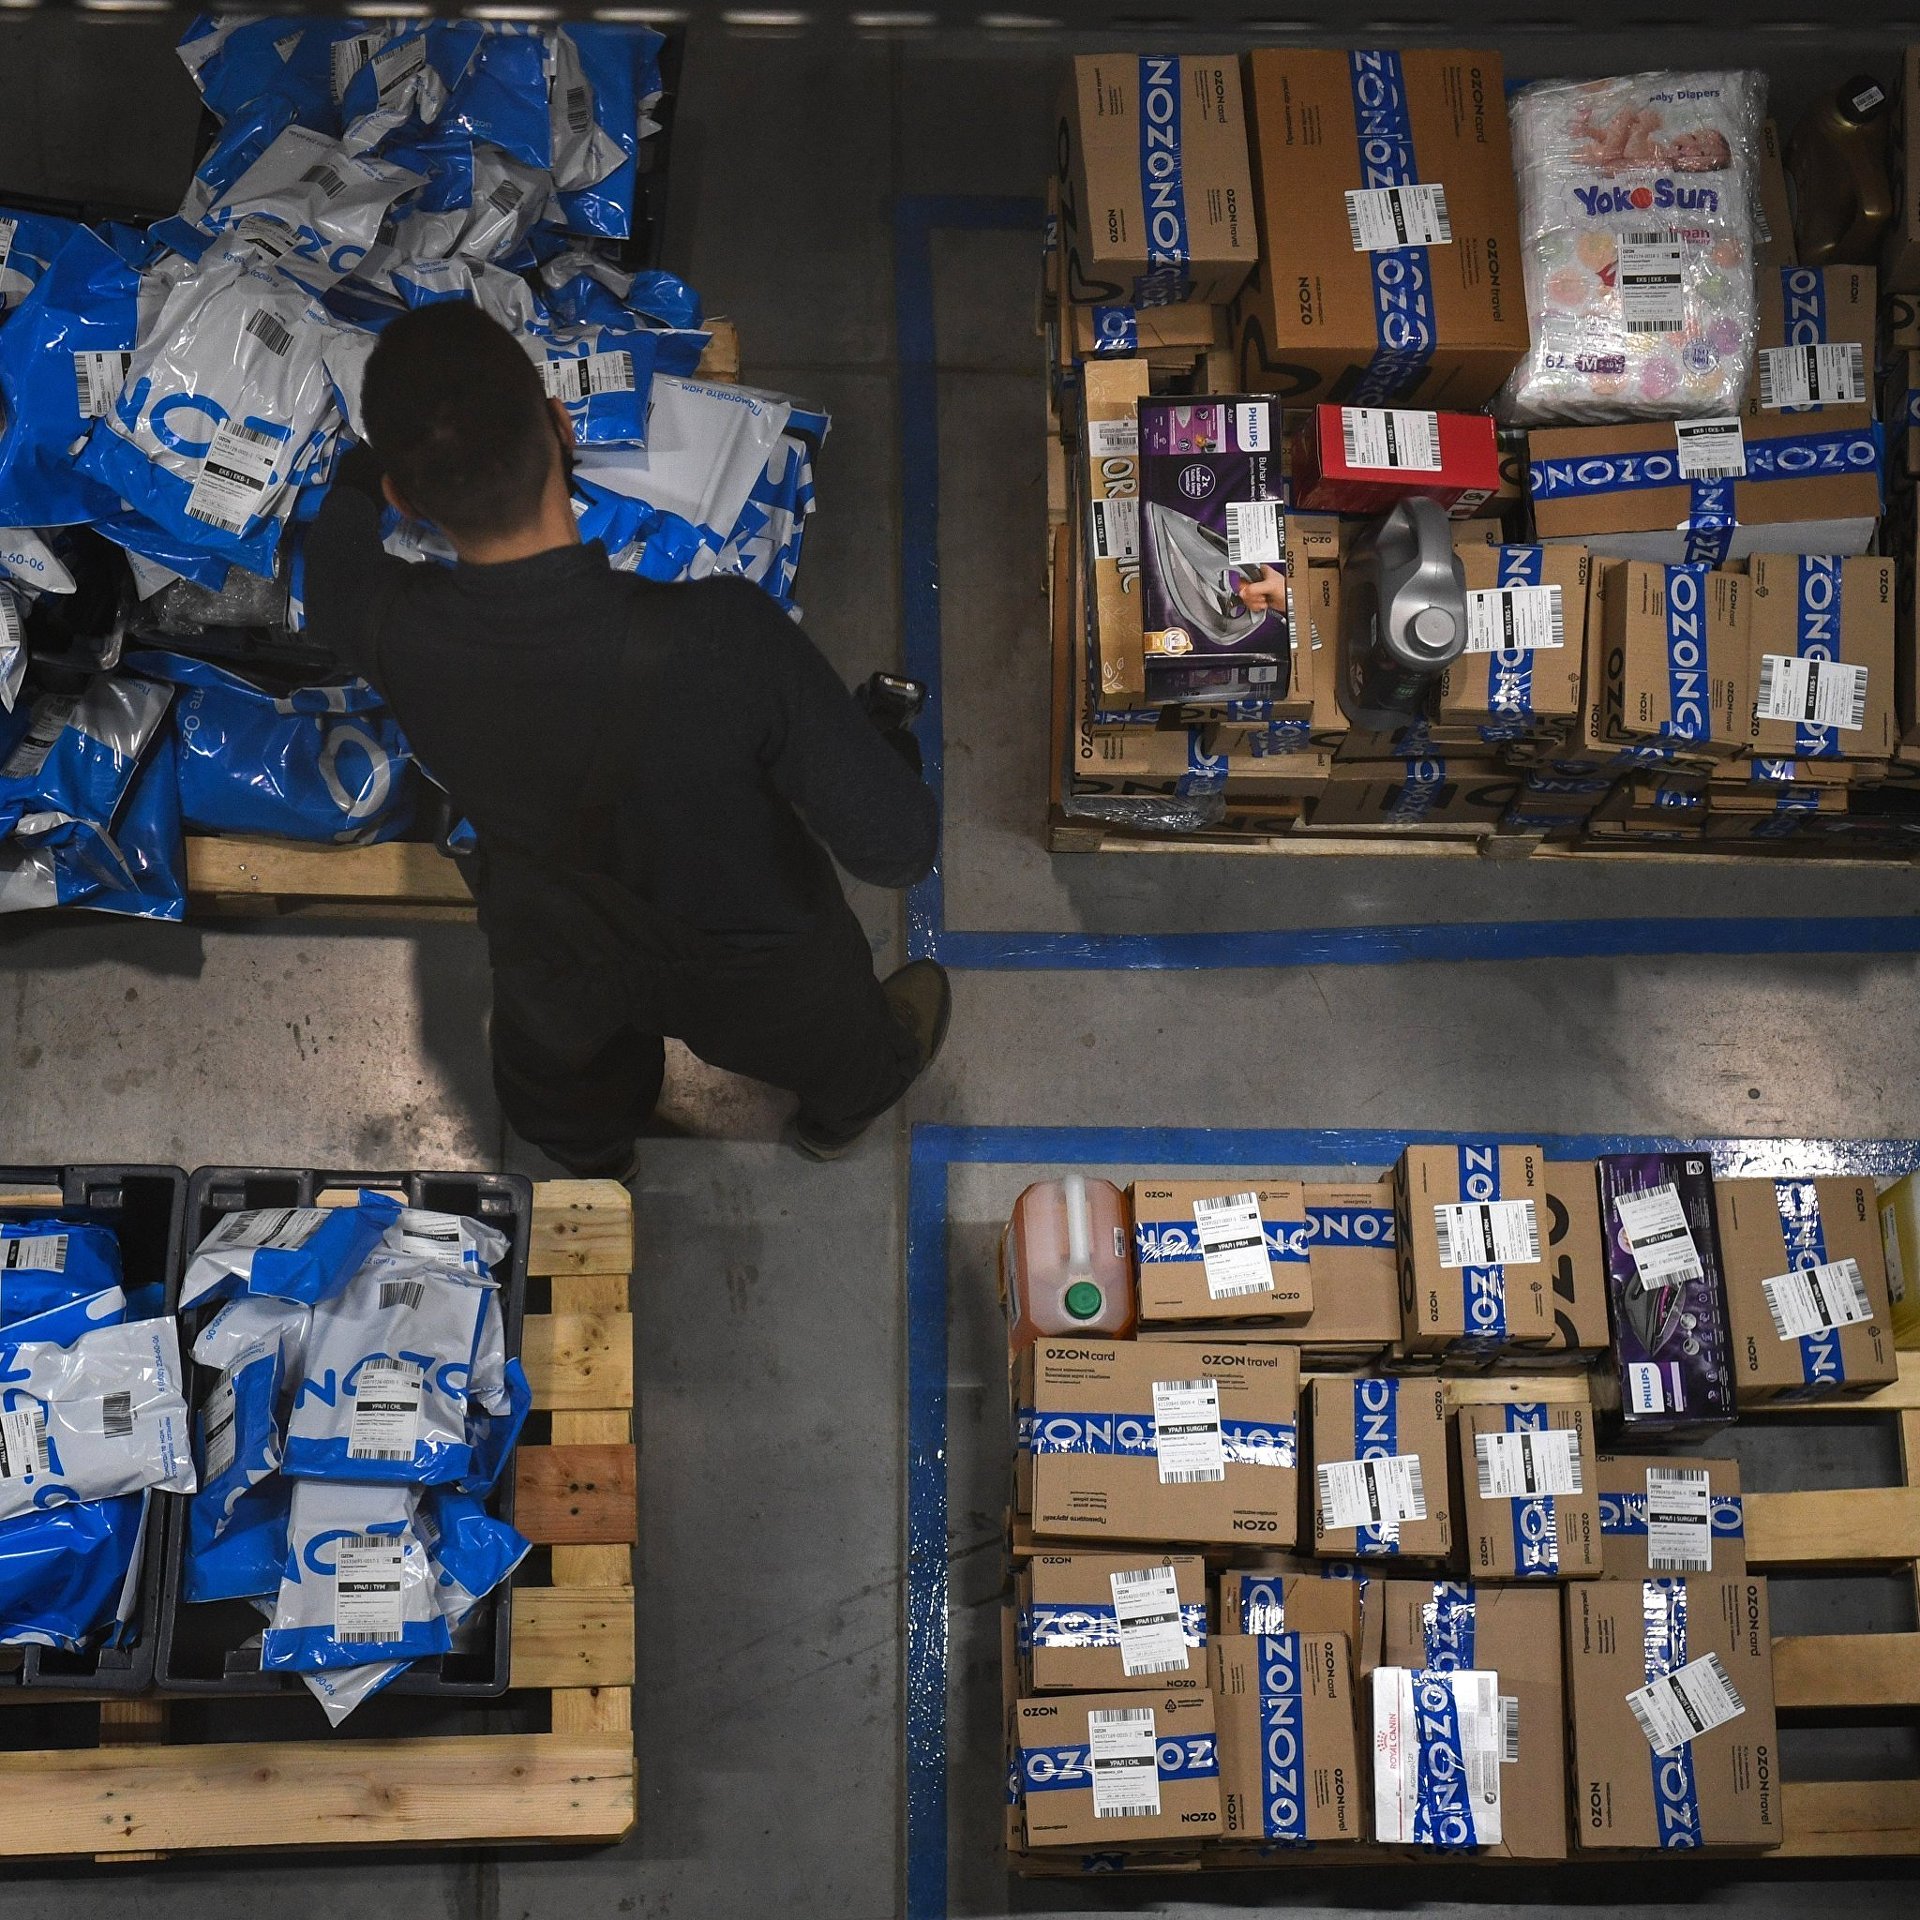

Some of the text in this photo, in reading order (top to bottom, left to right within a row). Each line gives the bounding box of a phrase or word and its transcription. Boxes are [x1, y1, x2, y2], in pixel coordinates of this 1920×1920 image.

[1214, 70, 1225, 105] OZON
[1470, 68, 1484, 118] OZON
[1677, 89, 1720, 102] Diapers
[1226, 188, 1237, 223] OZON
[1108, 210, 1118, 243] OZON
[1487, 238, 1504, 322] OZON travel
[1850, 274, 1859, 304] OZON
[1298, 276, 1312, 325] OZON
[1545, 355, 1598, 372] 62 M
[681, 383, 762, 417] Помогайте нам
[1248, 407, 1258, 448] PHILIPS
[1202, 475, 1210, 487] 2x
[1258, 456, 1267, 481] Buhar
[1578, 556, 1586, 585] OZON
[1880, 569, 1888, 603] OZON
[1322, 580, 1330, 607] OZON
[1730, 580, 1738, 606] OZON
[1591, 704, 1600, 737] OZON
[1525, 1156, 1534, 1187] OZON
[1856, 1188, 1865, 1222] OZON
[1218, 1239, 1249, 1250] УРАЛ PRM
[1271, 1292, 1300, 1300] OZON
[1430, 1291, 1438, 1322] OZON
[1046, 1349, 1115, 1362] OZON card
[1202, 1354, 1278, 1368] OZON travel
[1747, 1336, 1758, 1372] OZON
[1640, 1367, 1653, 1409] PHILIPS
[1435, 1391, 1443, 1420] OZON
[1186, 1424, 1209, 1432] SURGUT
[1068, 1515, 1106, 1524] Приводите
[1233, 1520, 1278, 1531] OZON
[1316, 1510, 1324, 1539] OZON
[1480, 1536, 1489, 1566] OZON
[1581, 1512, 1592, 1564] OZON travel
[1747, 1585, 1761, 1656] OZON card
[1166, 1680, 1196, 1688] OZON
[1324, 1642, 1336, 1698] OZON card
[1023, 1706, 1058, 1717] OZON
[1674, 1685, 1698, 1724] УРАЛ SURGUT
[1389, 1713, 1397, 1769] ROYAL CANIN
[1334, 1768, 1347, 1832] OZON travel
[1756, 1745, 1772, 1825] OZON travel
[1181, 1812, 1216, 1823] OZON
[1227, 1794, 1237, 1831] OZON
[1591, 1782, 1602, 1828] OZON
